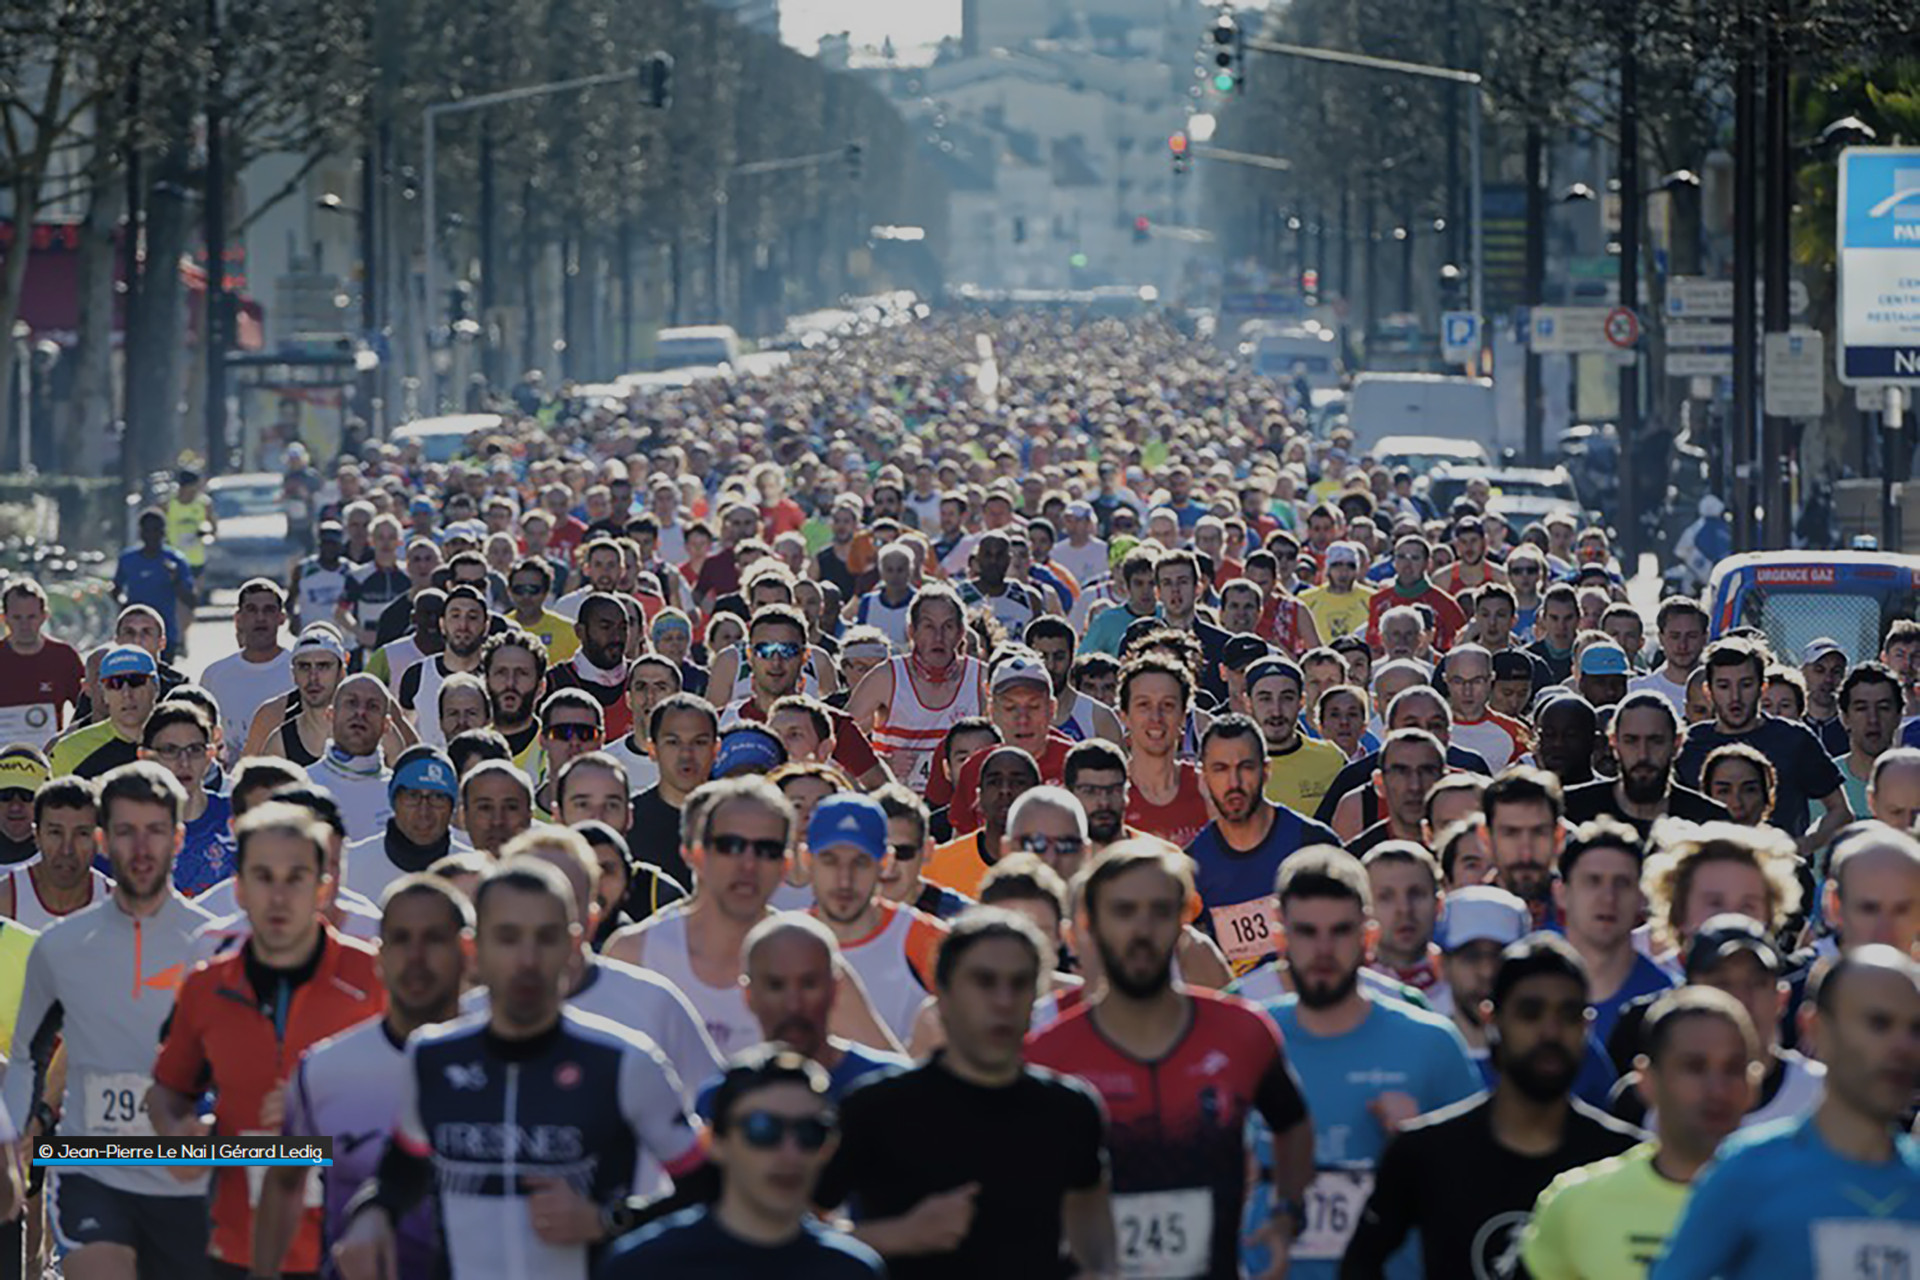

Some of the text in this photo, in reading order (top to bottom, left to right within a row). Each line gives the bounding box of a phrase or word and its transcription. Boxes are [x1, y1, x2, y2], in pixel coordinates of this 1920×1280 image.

[1757, 568, 1833, 581] URGENCE GAZ
[1231, 913, 1269, 943] 183
[1122, 1212, 1187, 1258] 245
